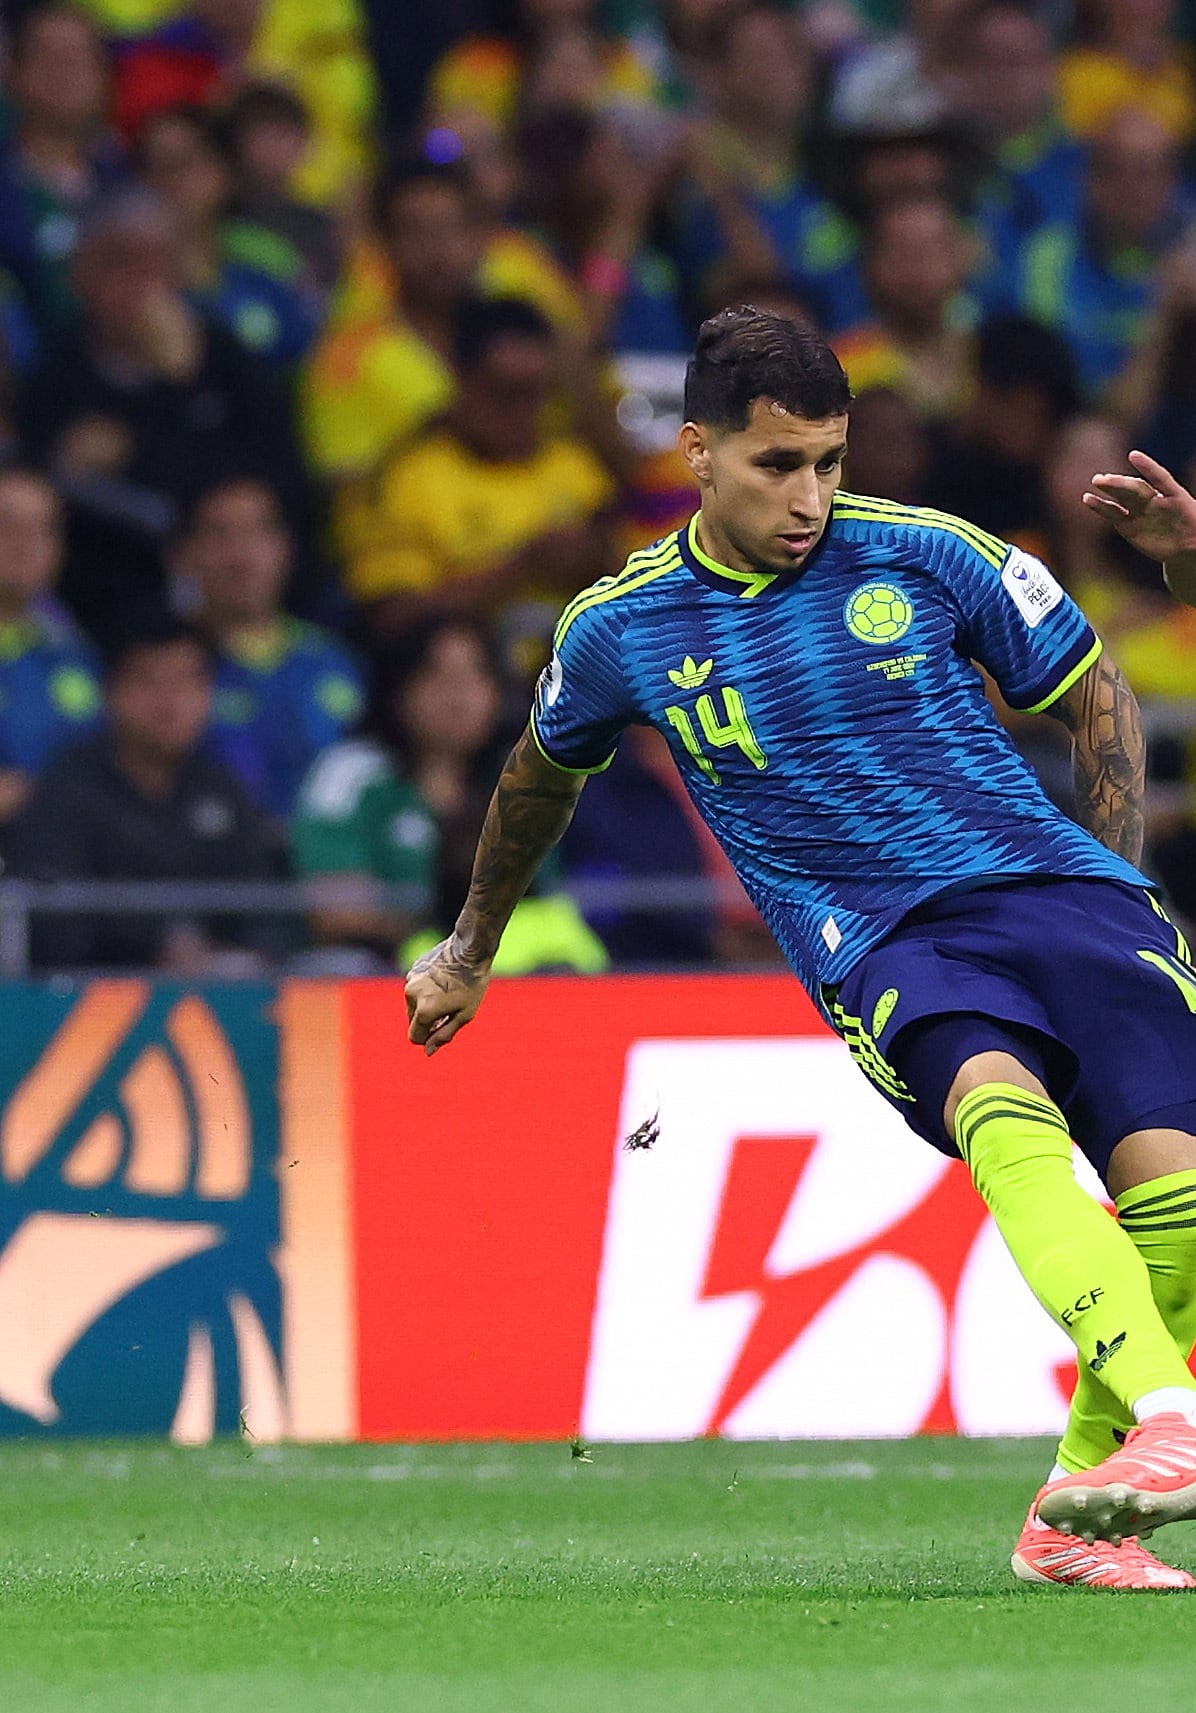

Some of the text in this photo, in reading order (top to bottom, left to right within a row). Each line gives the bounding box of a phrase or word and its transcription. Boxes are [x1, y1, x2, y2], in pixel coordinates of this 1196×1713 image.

[1027, 582, 1051, 606] PEAC
[664, 686, 768, 787] 14
[1060, 1287, 1105, 1328] FCF
